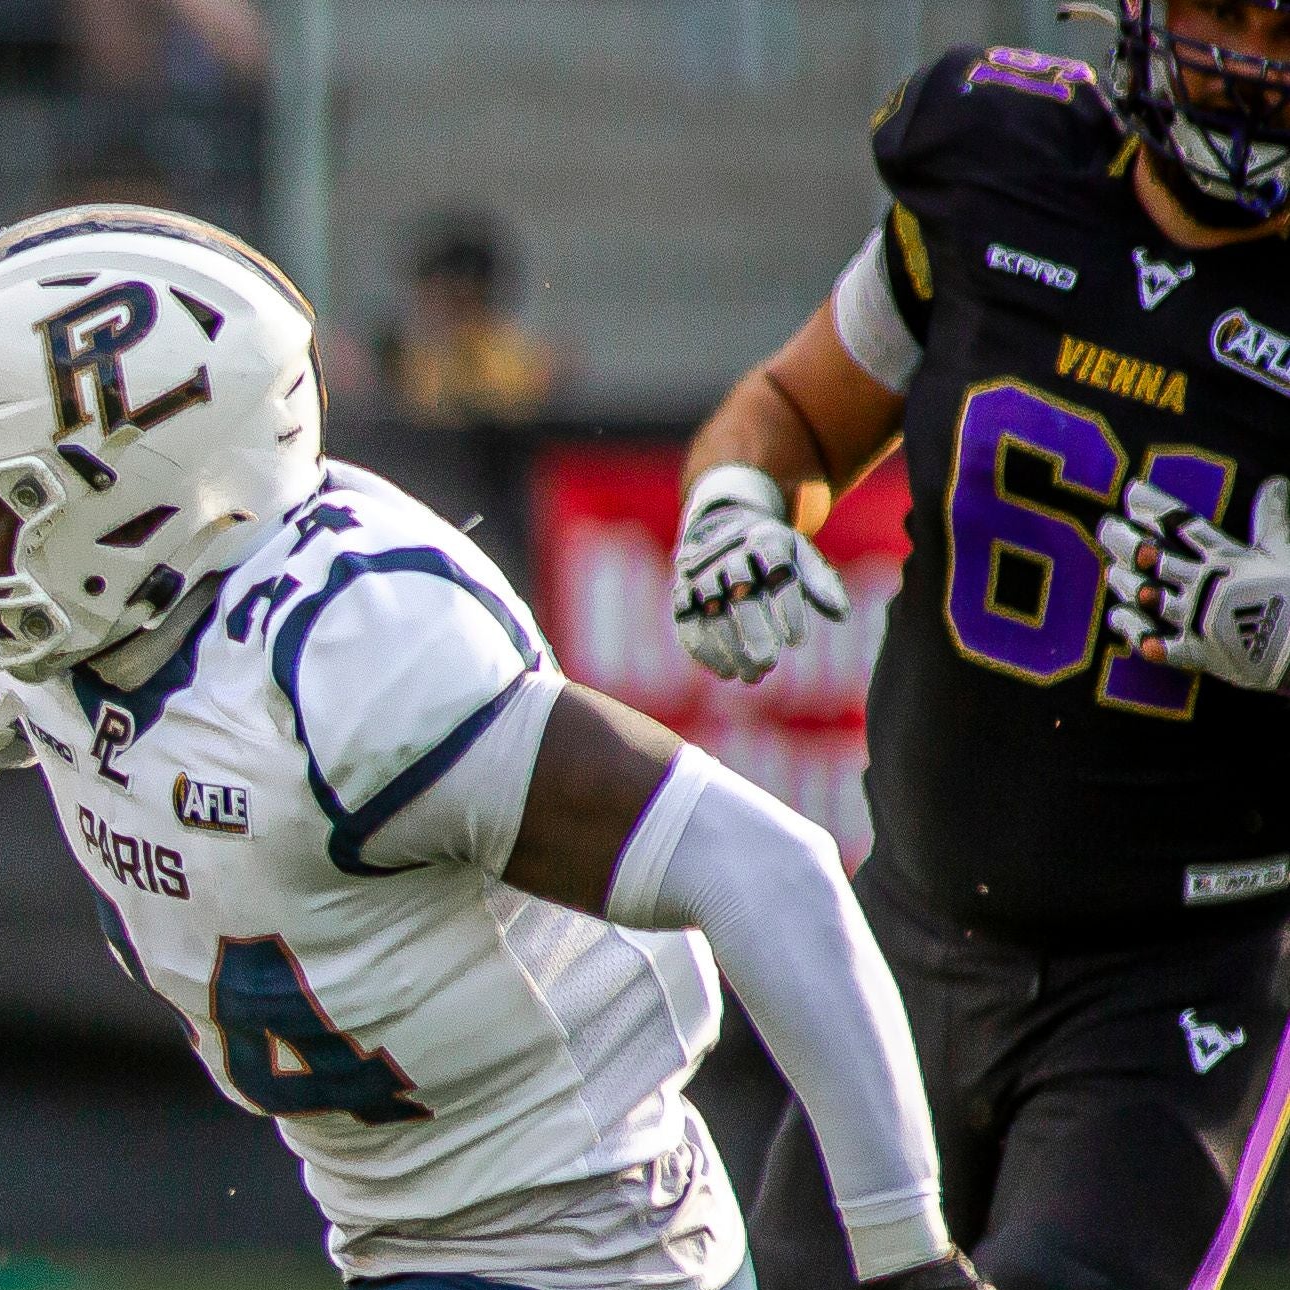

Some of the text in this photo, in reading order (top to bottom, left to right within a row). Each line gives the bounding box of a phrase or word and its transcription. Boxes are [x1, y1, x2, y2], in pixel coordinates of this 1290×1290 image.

[1055, 335, 1188, 415] VIENNA
[1221, 325, 1290, 378] AFL
[183, 782, 247, 826] AFLE
[78, 802, 190, 900] PARIS
